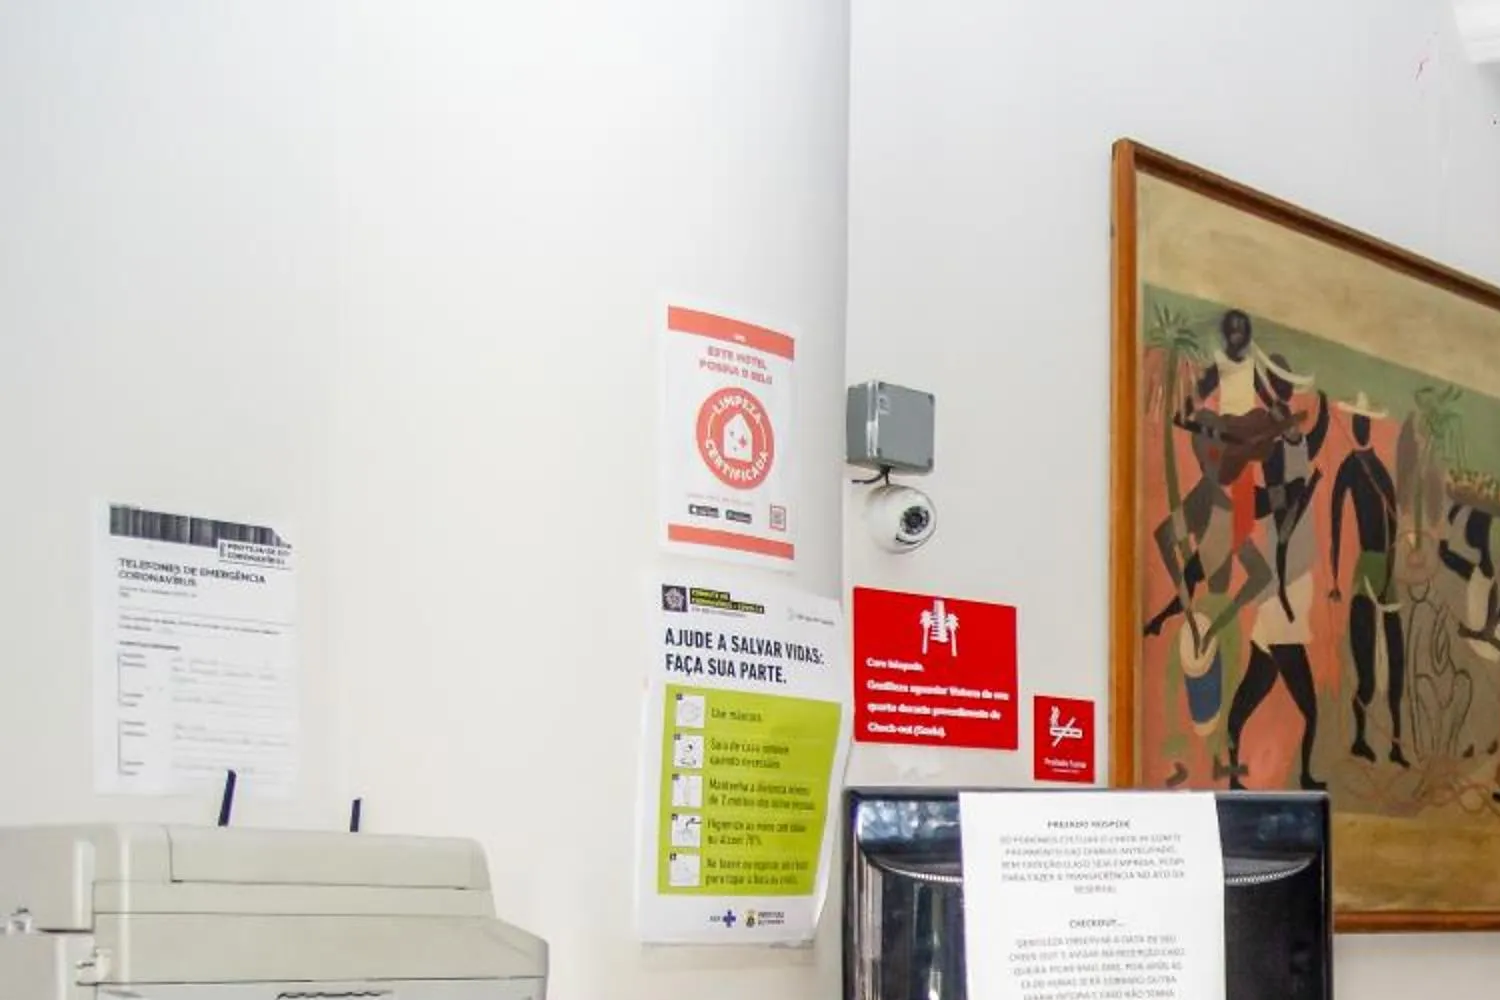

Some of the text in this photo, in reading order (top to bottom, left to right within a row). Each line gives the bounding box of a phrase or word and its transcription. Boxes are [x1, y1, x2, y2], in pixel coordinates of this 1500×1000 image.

[119, 558, 181, 576] TELEFONES
[184, 566, 198, 576] DE
[666, 628, 824, 664] AJUDE A SALVAR VIDAS:
[666, 654, 787, 684] FAÇA SUA PARTE.
